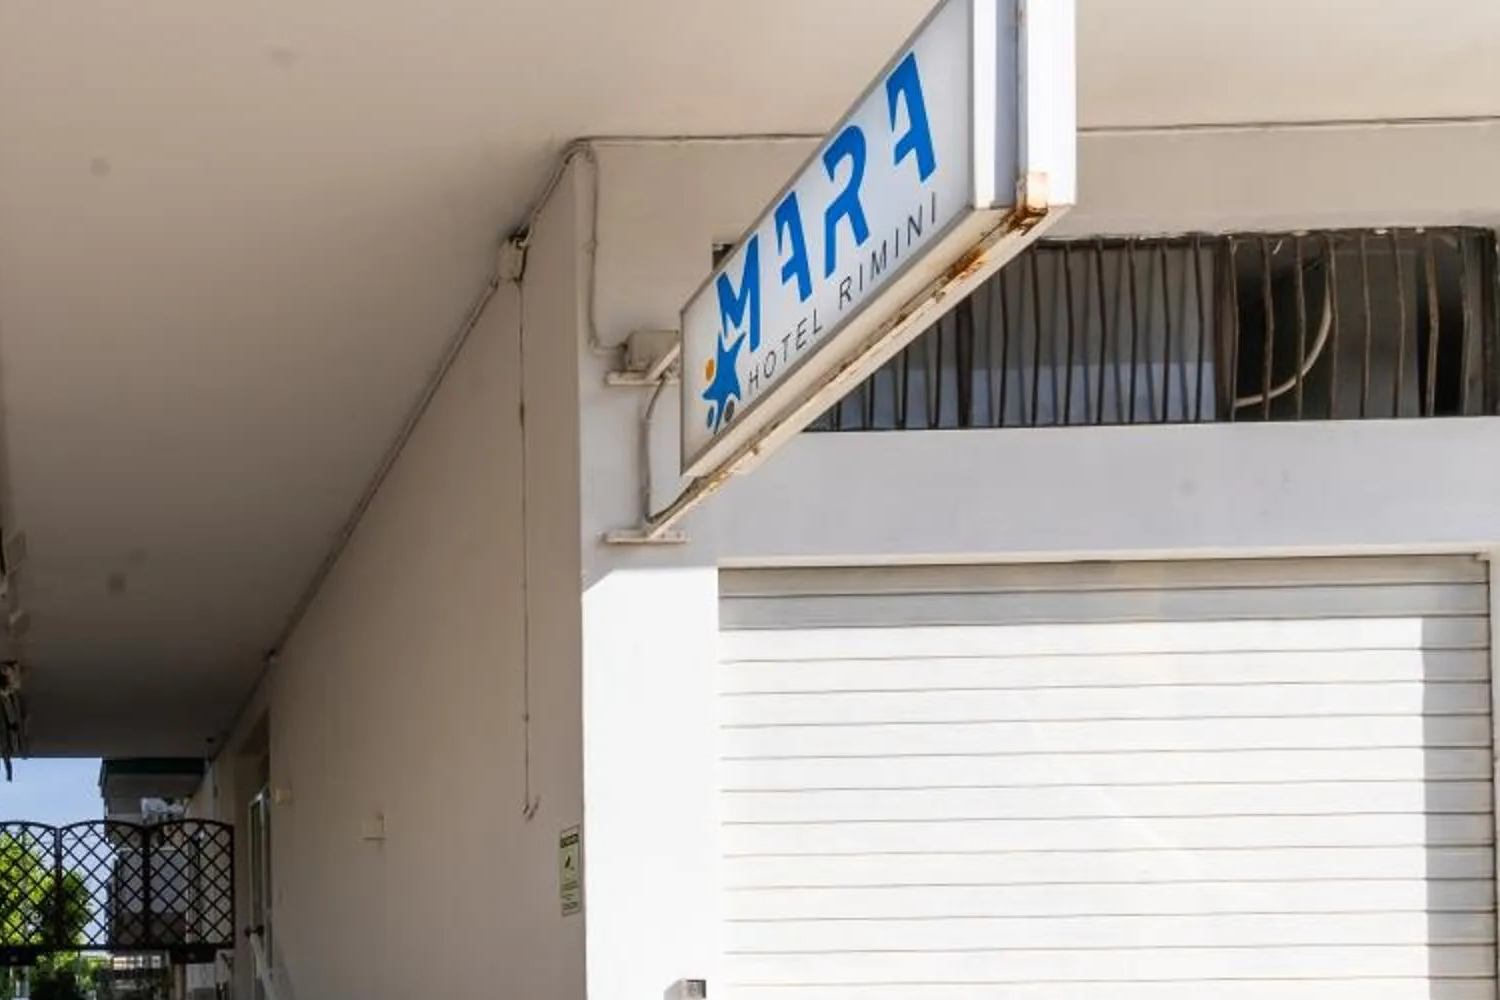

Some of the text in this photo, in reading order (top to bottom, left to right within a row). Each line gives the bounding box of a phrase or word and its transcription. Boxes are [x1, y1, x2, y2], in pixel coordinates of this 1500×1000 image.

[715, 51, 937, 353] MARA
[748, 191, 936, 395] HOTEL RIMINI
